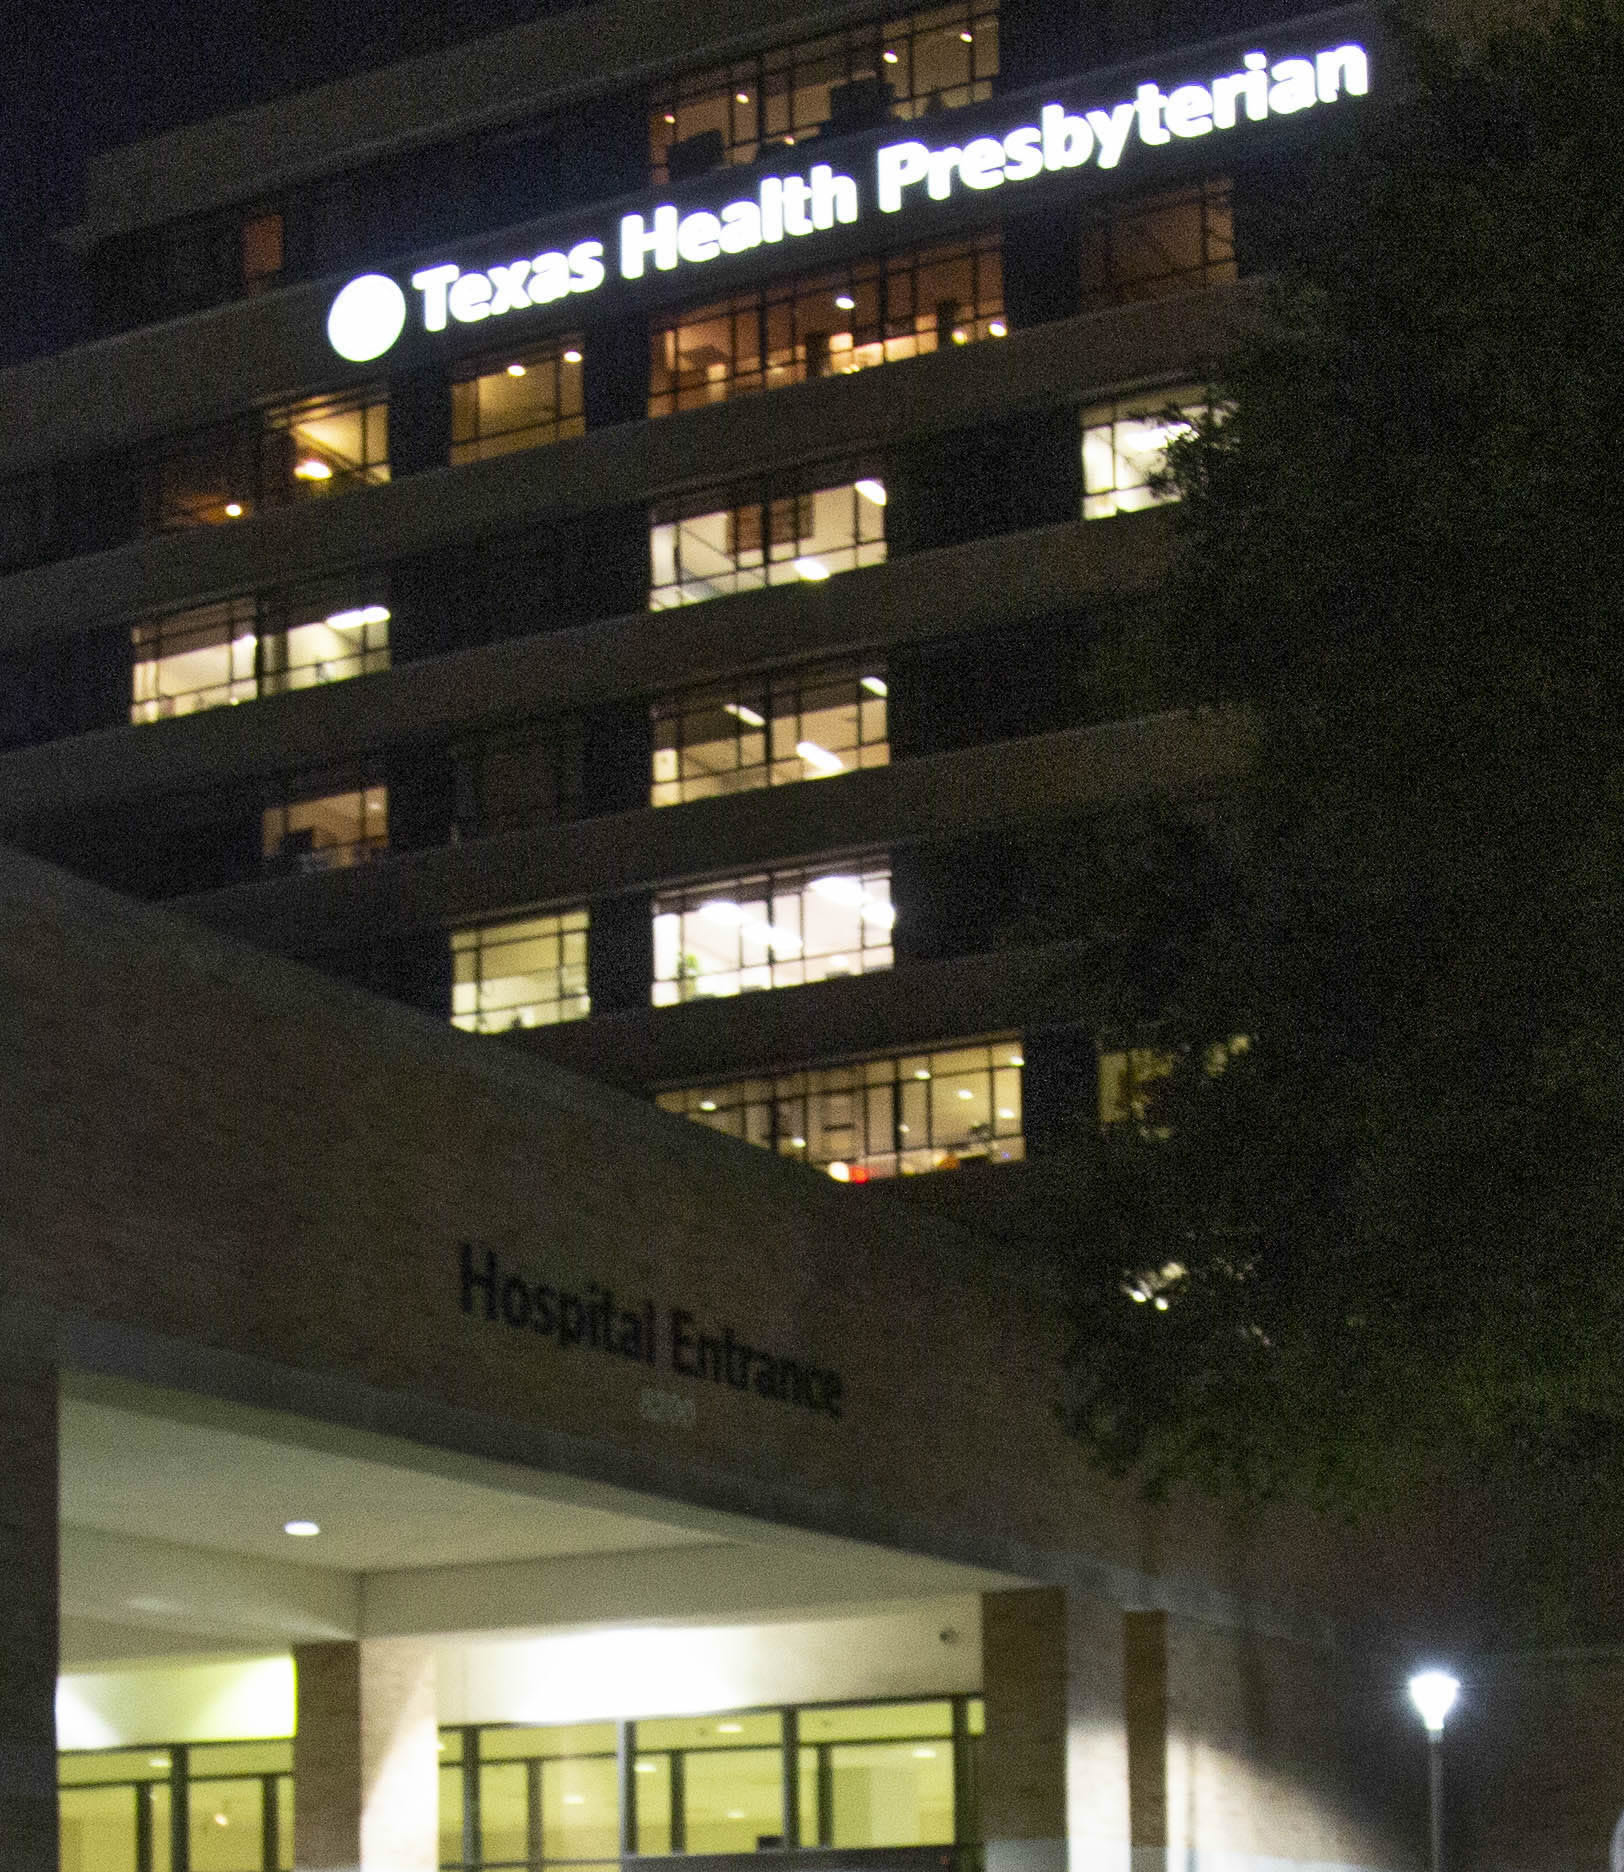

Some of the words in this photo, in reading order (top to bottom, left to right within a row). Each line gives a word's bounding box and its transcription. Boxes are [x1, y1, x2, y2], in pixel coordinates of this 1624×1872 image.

[411, 237, 605, 332] Texas
[619, 162, 857, 280] Health
[876, 41, 1369, 214] Presbyterian
[458, 1241, 656, 1366] Hospital
[671, 1308, 845, 1422] Entrance
